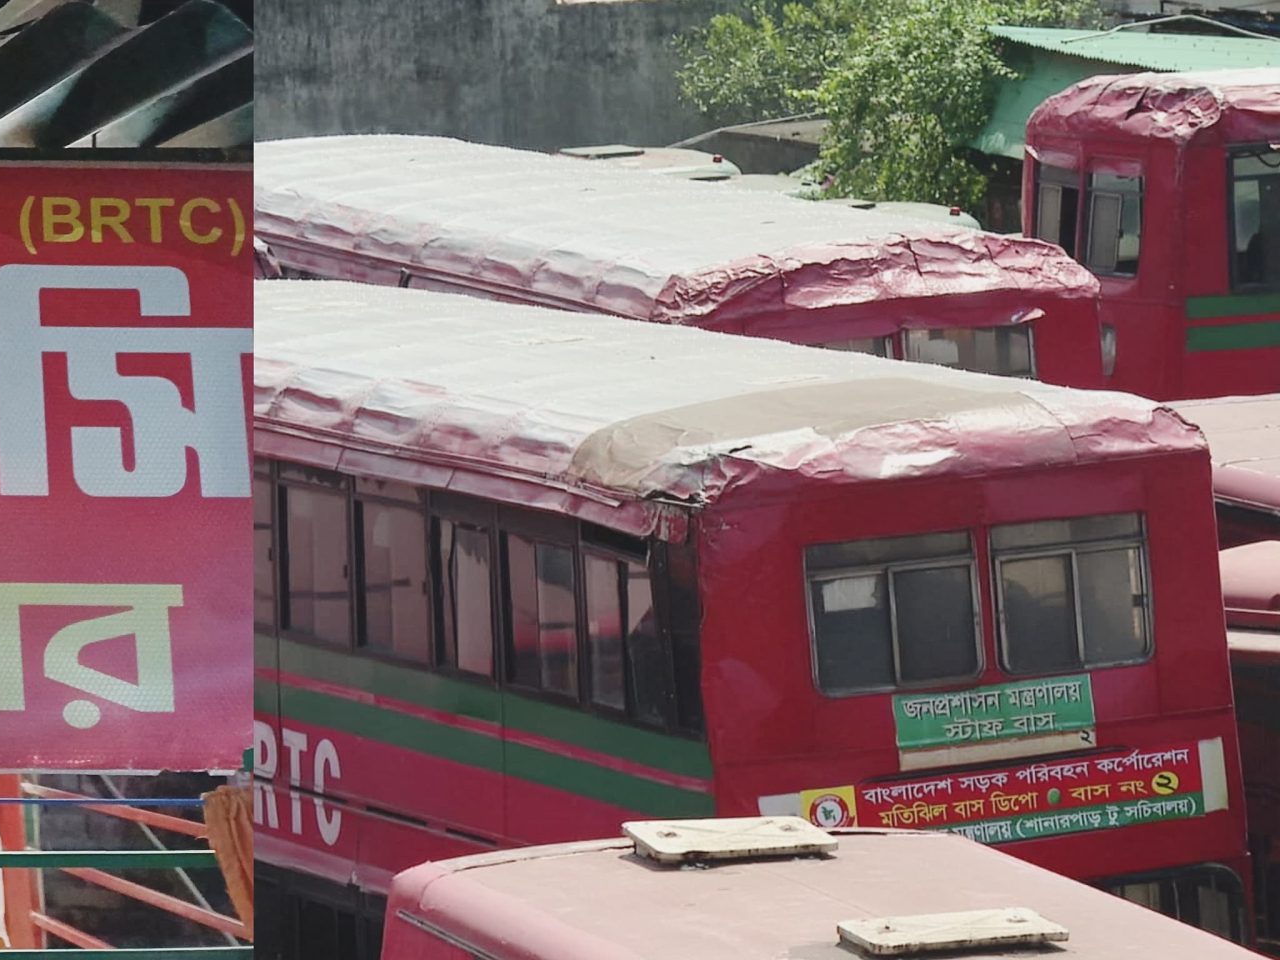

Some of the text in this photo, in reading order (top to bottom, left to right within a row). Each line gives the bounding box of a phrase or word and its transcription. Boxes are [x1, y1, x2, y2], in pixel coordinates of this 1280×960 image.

[20, 194, 246, 256] (BRTC)
[902, 691, 1001, 720] জনপ্রশাসন
[943, 711, 1057, 741] স্টাফ বাস
[862, 746, 1190, 805] বাংলাদেশ সড়ক পরিবহন কর্পোরেশন
[953, 796, 986, 818] বাস
[990, 789, 1039, 814] ডিপো
[1068, 782, 1113, 803] বাস
[1120, 778, 1148, 798] নং
[1154, 773, 1178, 793] ২
[1106, 803, 1123, 827] টু
